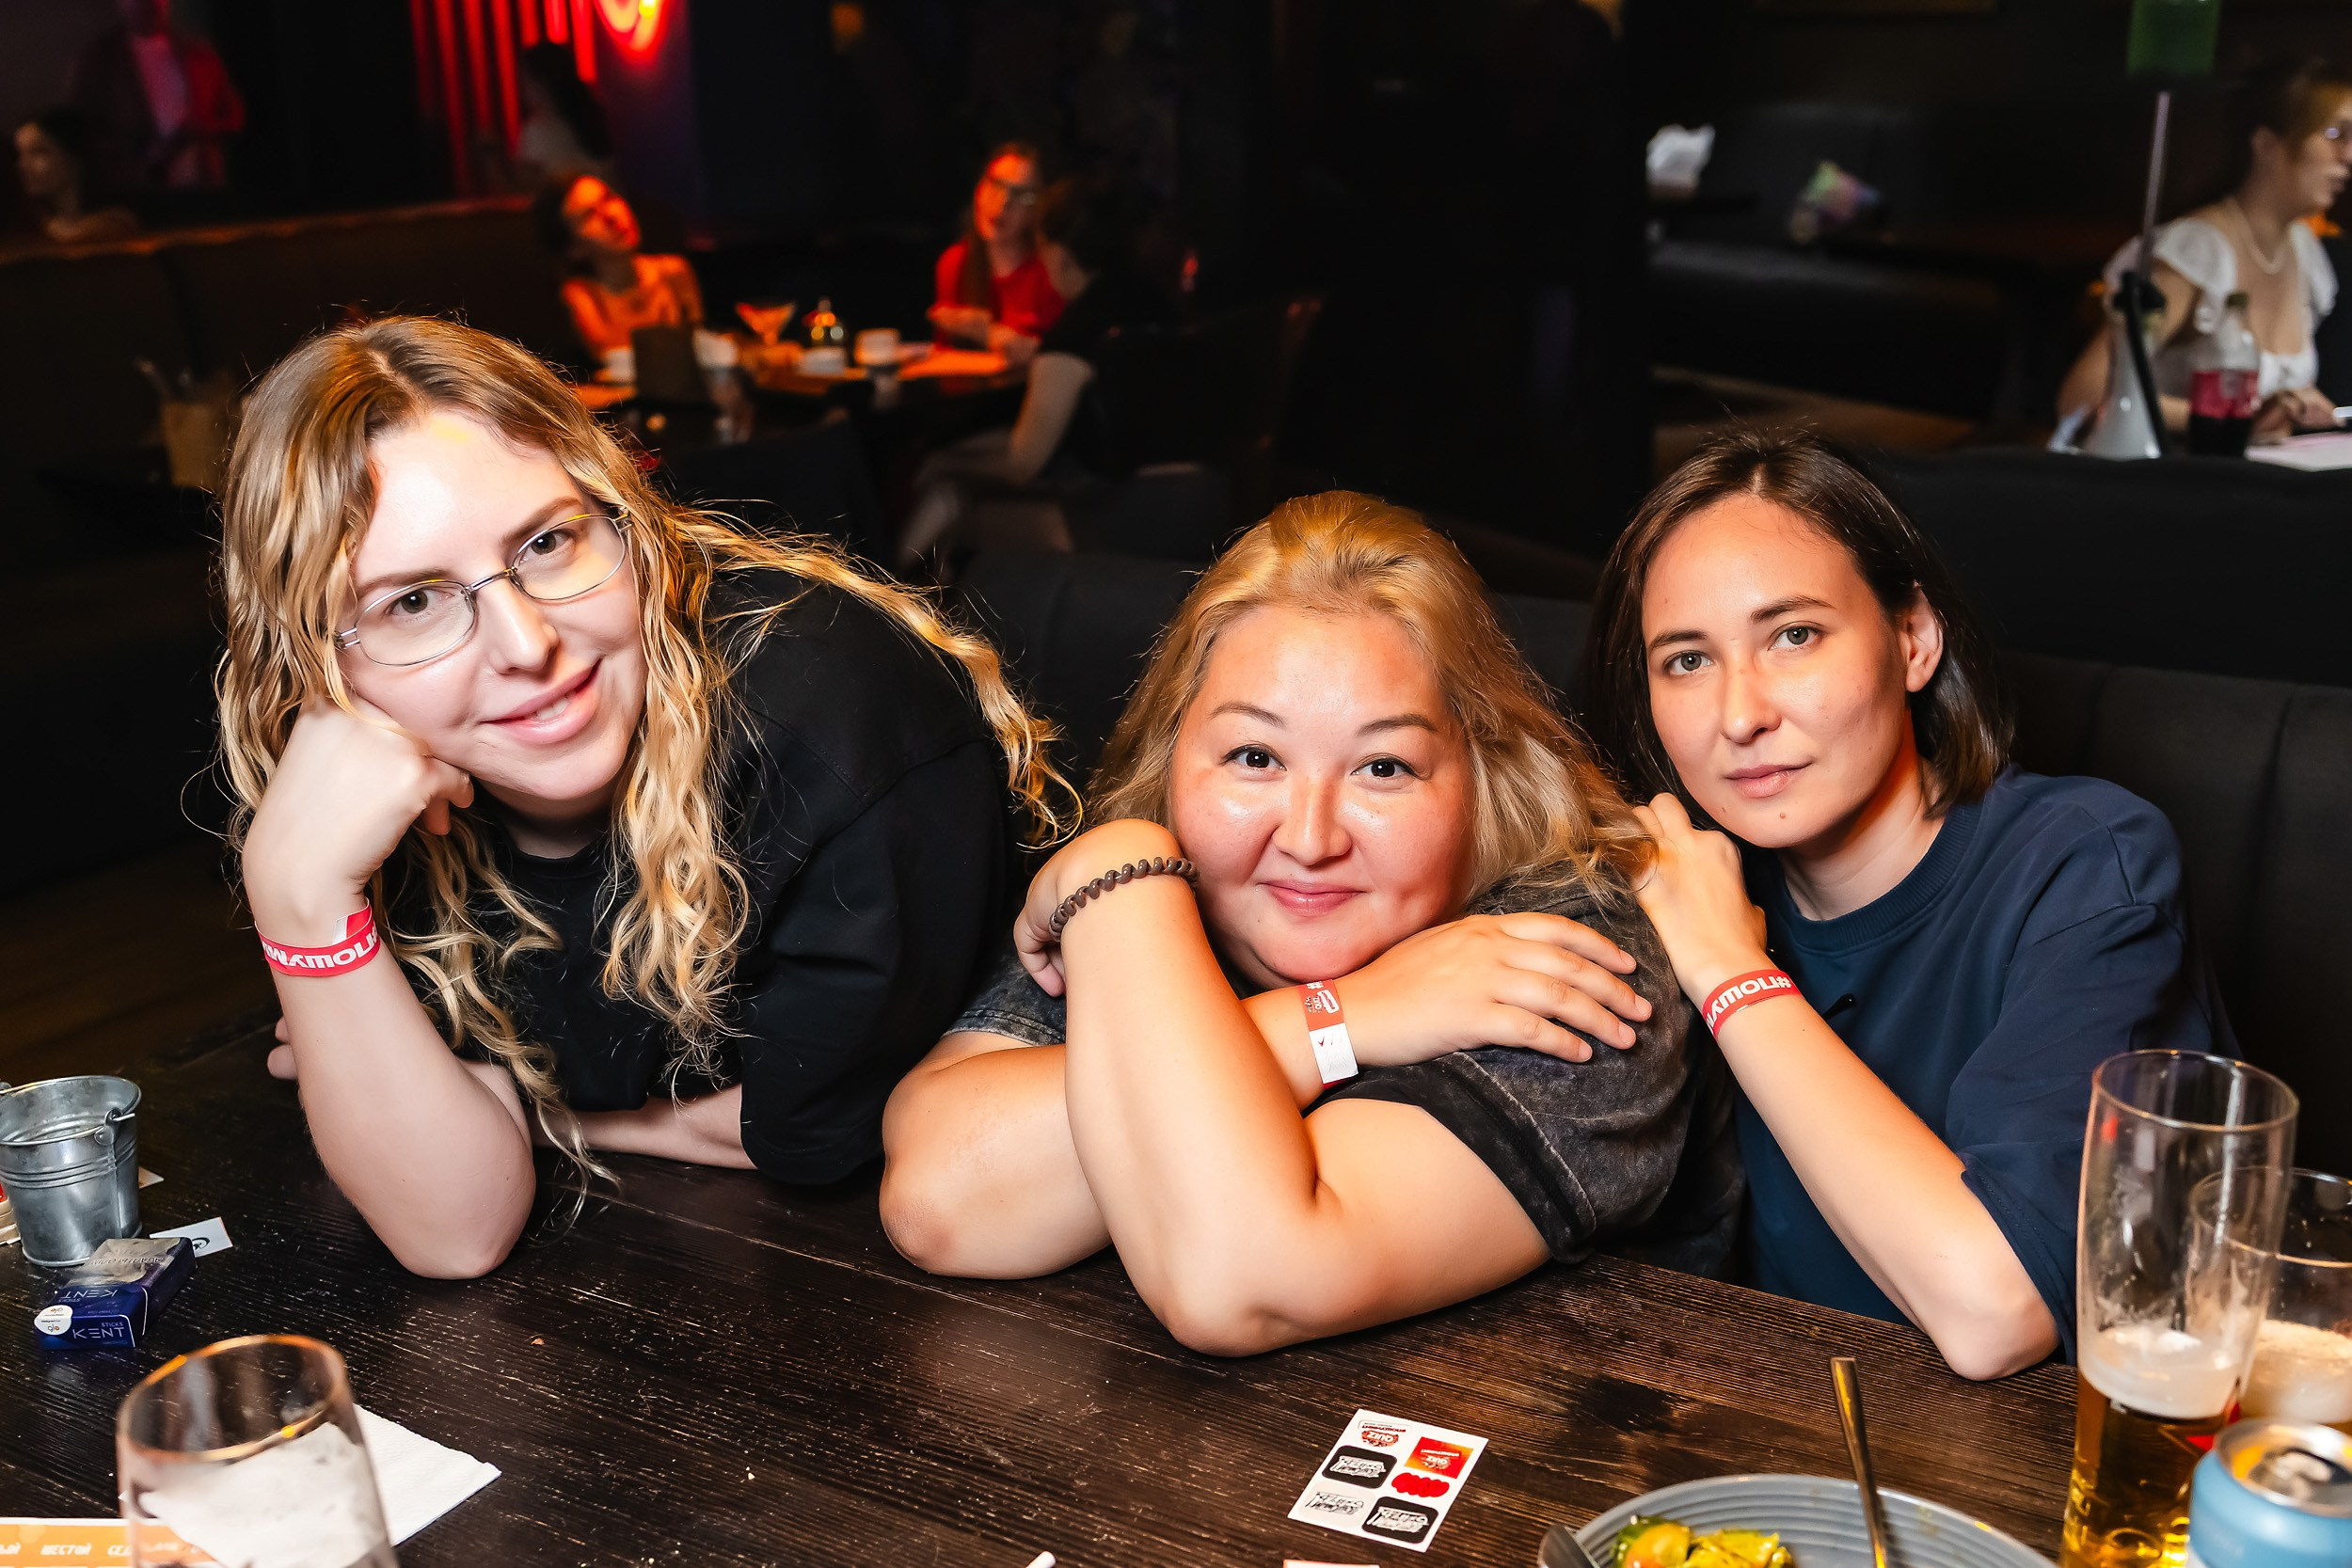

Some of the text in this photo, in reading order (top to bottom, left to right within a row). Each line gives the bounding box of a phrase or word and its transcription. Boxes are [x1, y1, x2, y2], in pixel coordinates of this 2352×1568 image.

[61, 1289, 118, 1298] KENT
[72, 1327, 125, 1339] KENT
[1367, 1432, 1393, 1443] QUIZ
[40, 1543, 91, 1555] ШЕСТОЙ
